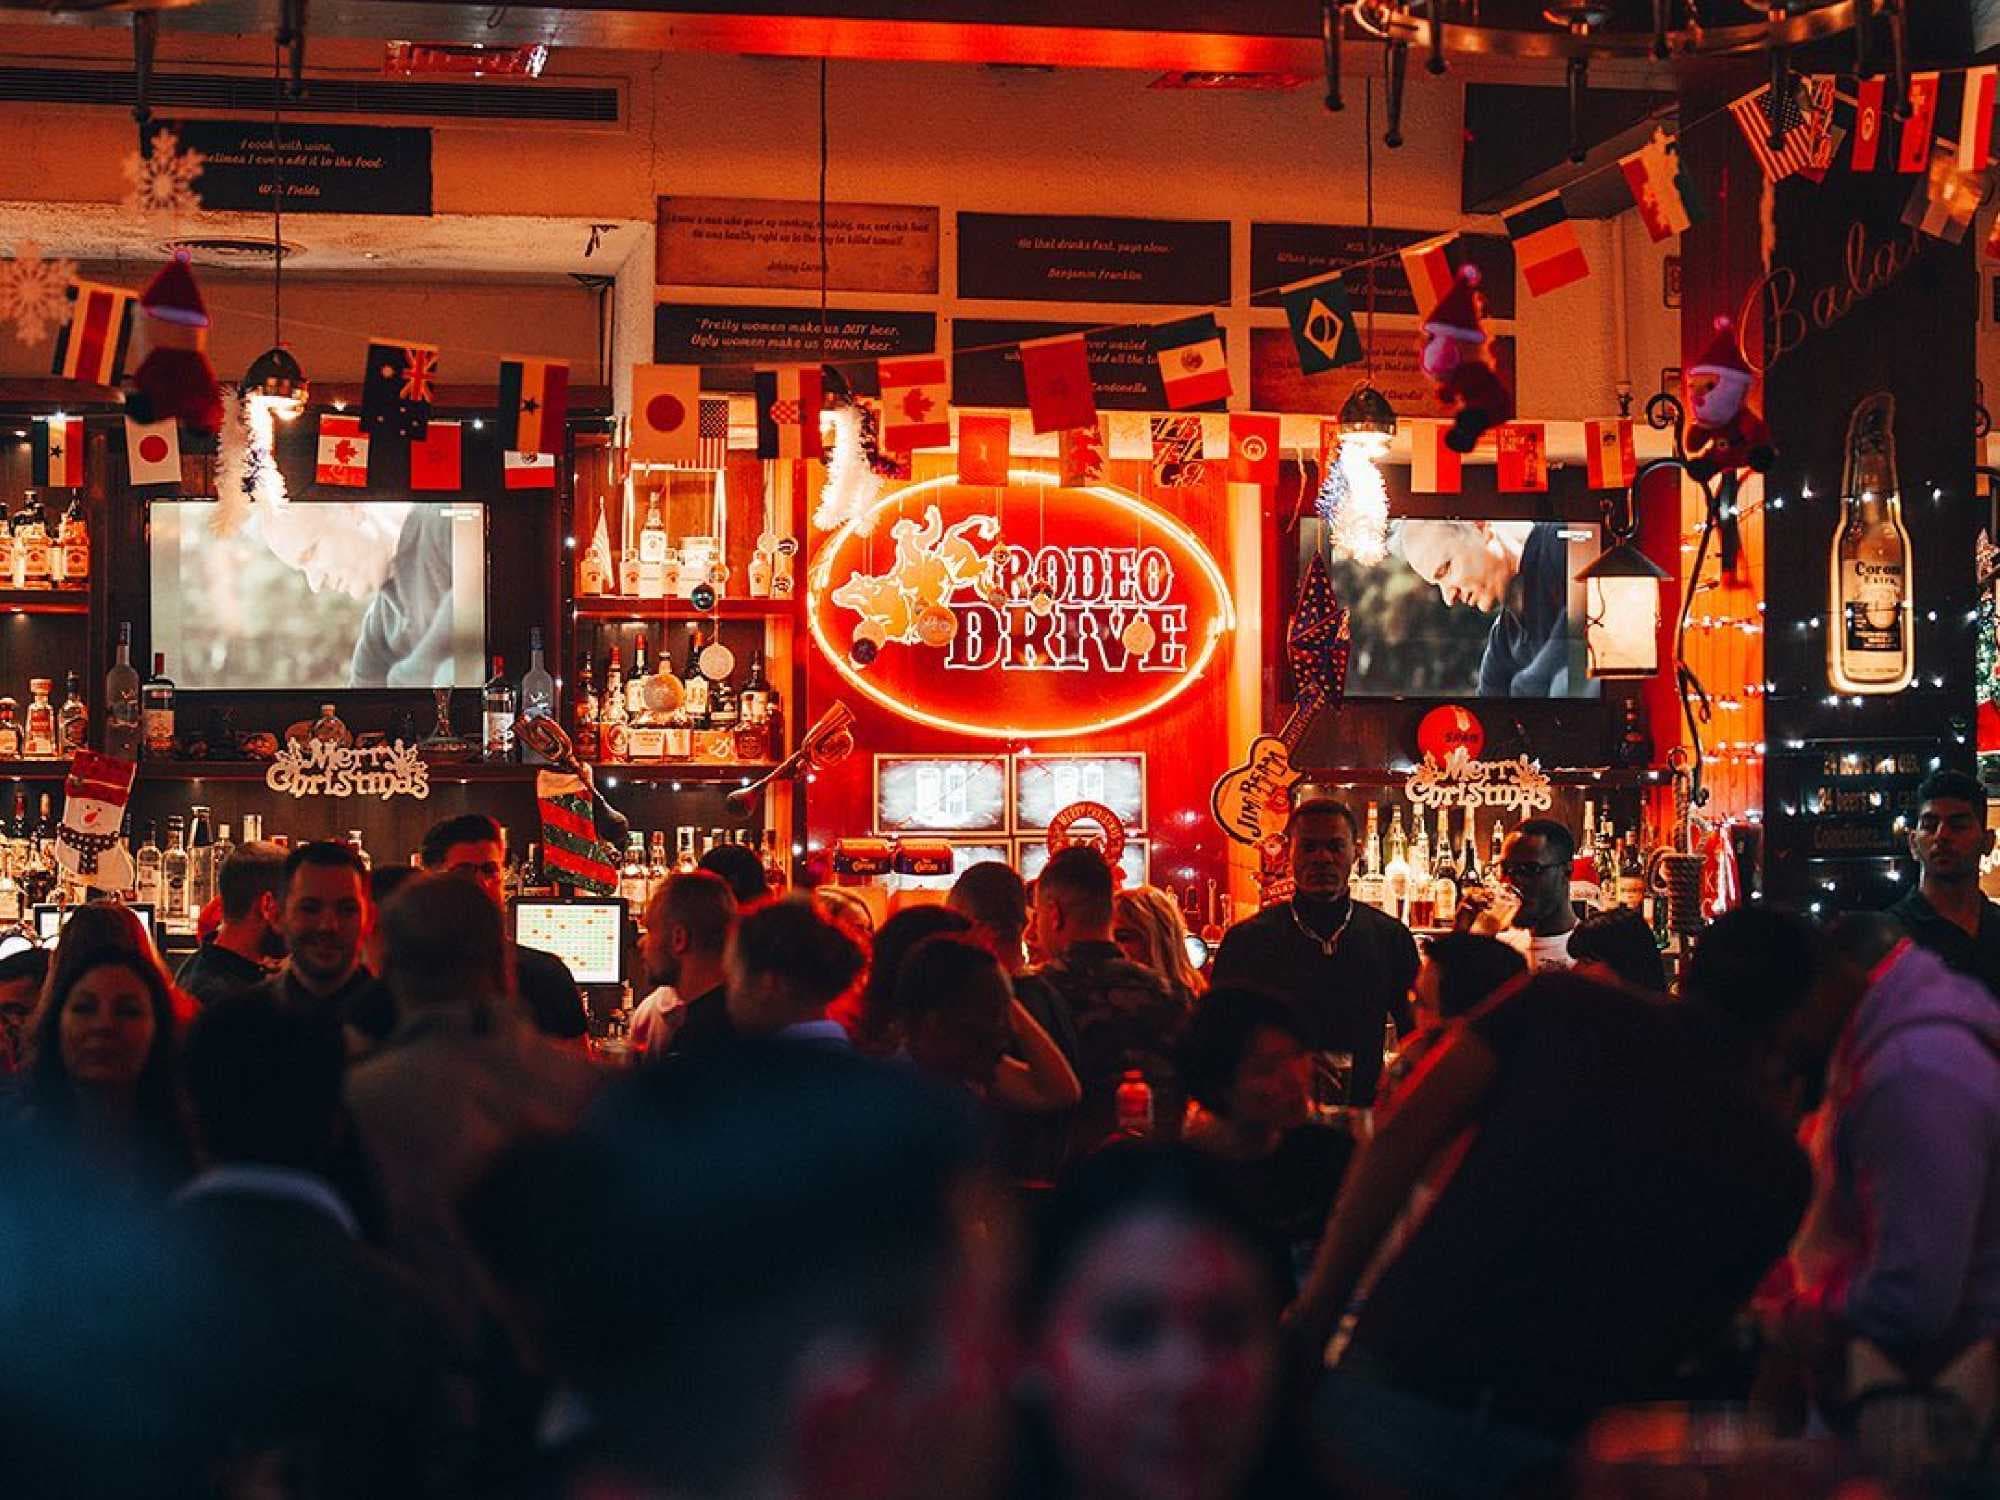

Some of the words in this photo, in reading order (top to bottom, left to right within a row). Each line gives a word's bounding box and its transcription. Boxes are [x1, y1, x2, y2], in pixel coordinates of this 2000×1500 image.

[722, 337, 766, 349] women
[767, 337, 801, 349] make
[743, 321, 786, 333] women
[787, 321, 822, 334] make
[990, 545, 1173, 606] RODEO
[944, 602, 1188, 672] DRIVE
[308, 737, 393, 772] Merry
[1443, 750, 1521, 785] Merry
[265, 760, 431, 800] Christmas
[1404, 773, 1552, 812] Christmas
[1236, 796, 1262, 838] JIM
